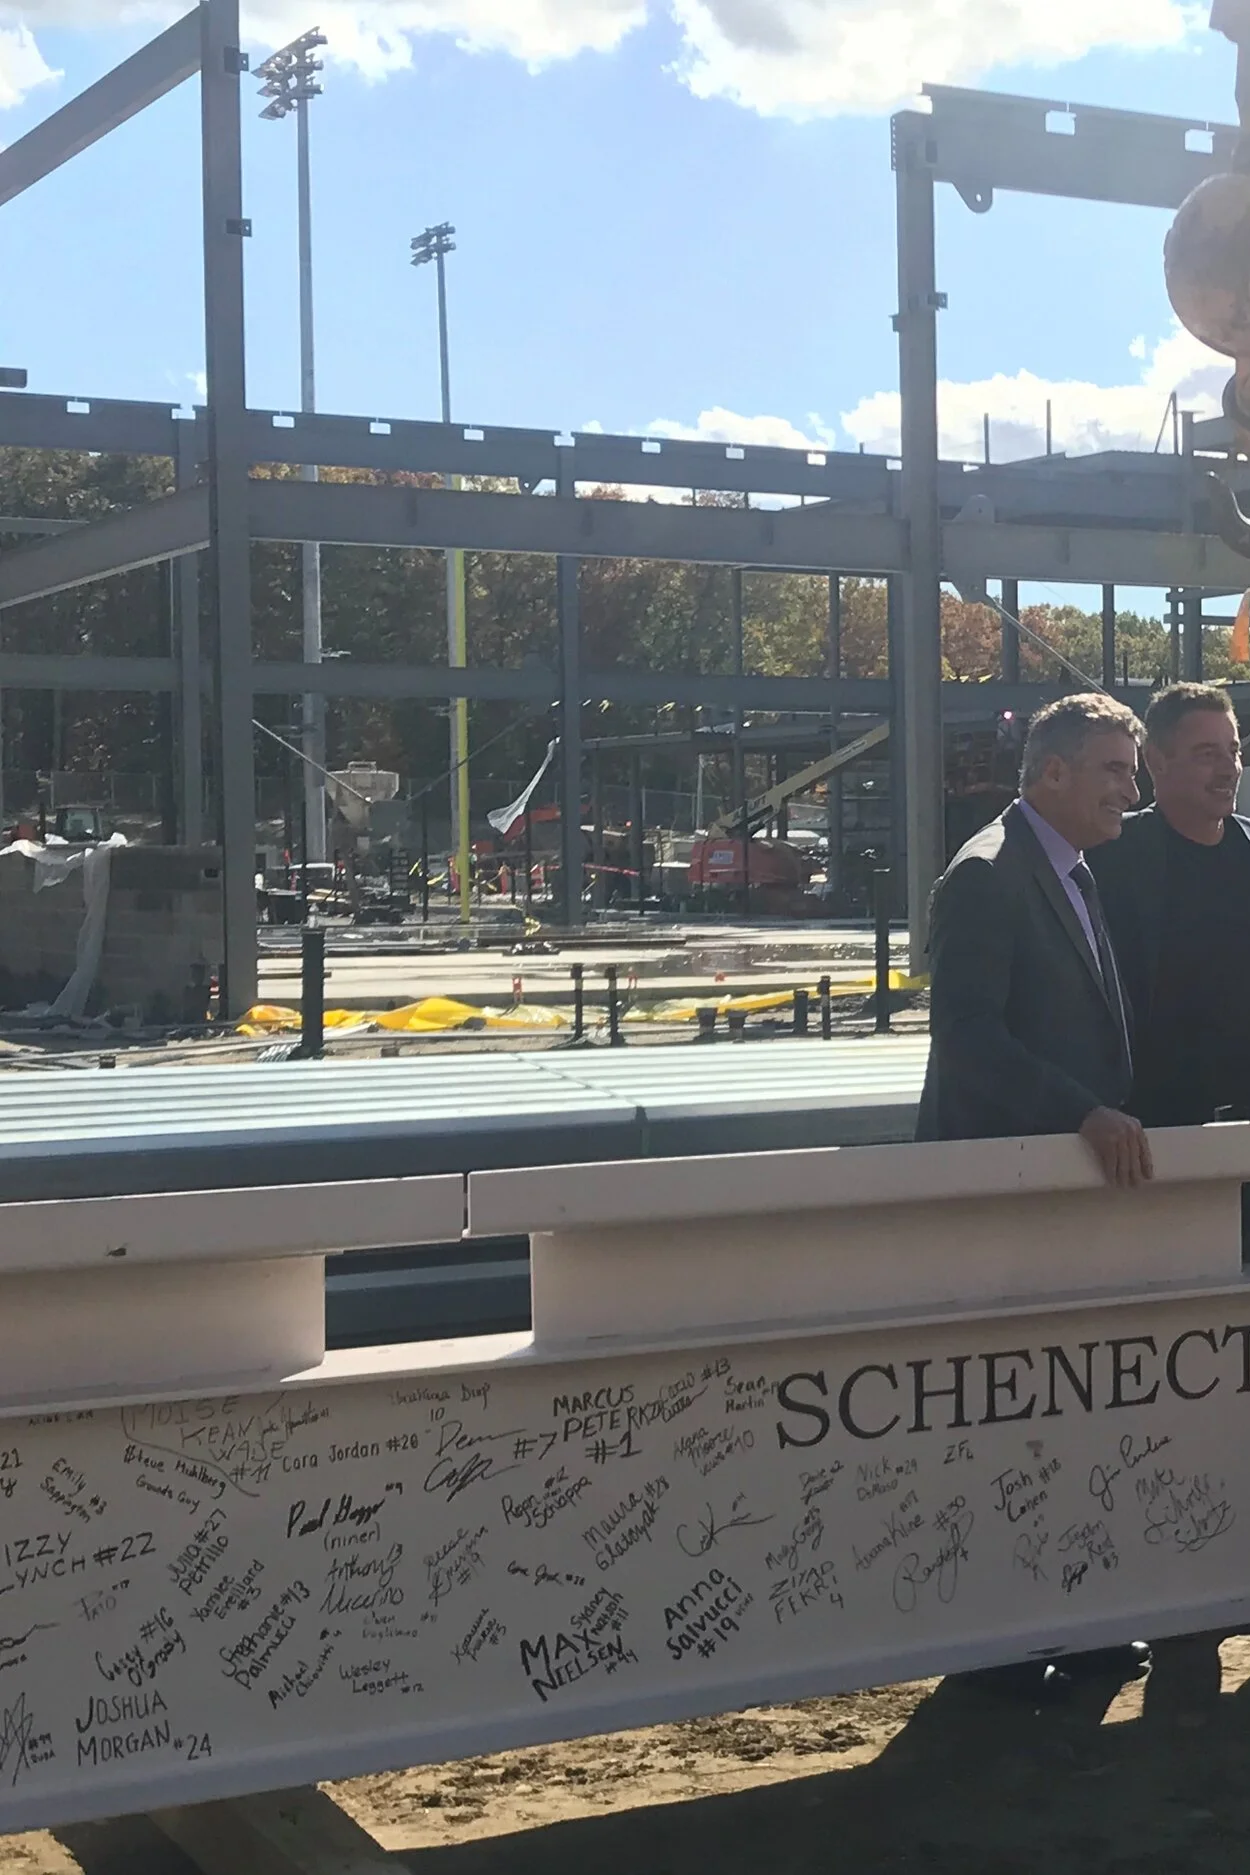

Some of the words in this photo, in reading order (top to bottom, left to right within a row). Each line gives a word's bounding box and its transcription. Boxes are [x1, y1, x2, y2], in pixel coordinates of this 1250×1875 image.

[553, 1384, 635, 1417] MARCUS
[512, 1430, 558, 1461] #7
[584, 1430, 644, 1465] #1
[990, 1467, 1034, 1512] Josh
[663, 1567, 726, 1631] Anna
[520, 1628, 603, 1676] MAX
[75, 1689, 169, 1734] JOSHUA
[76, 1719, 172, 1767] MORGAN
